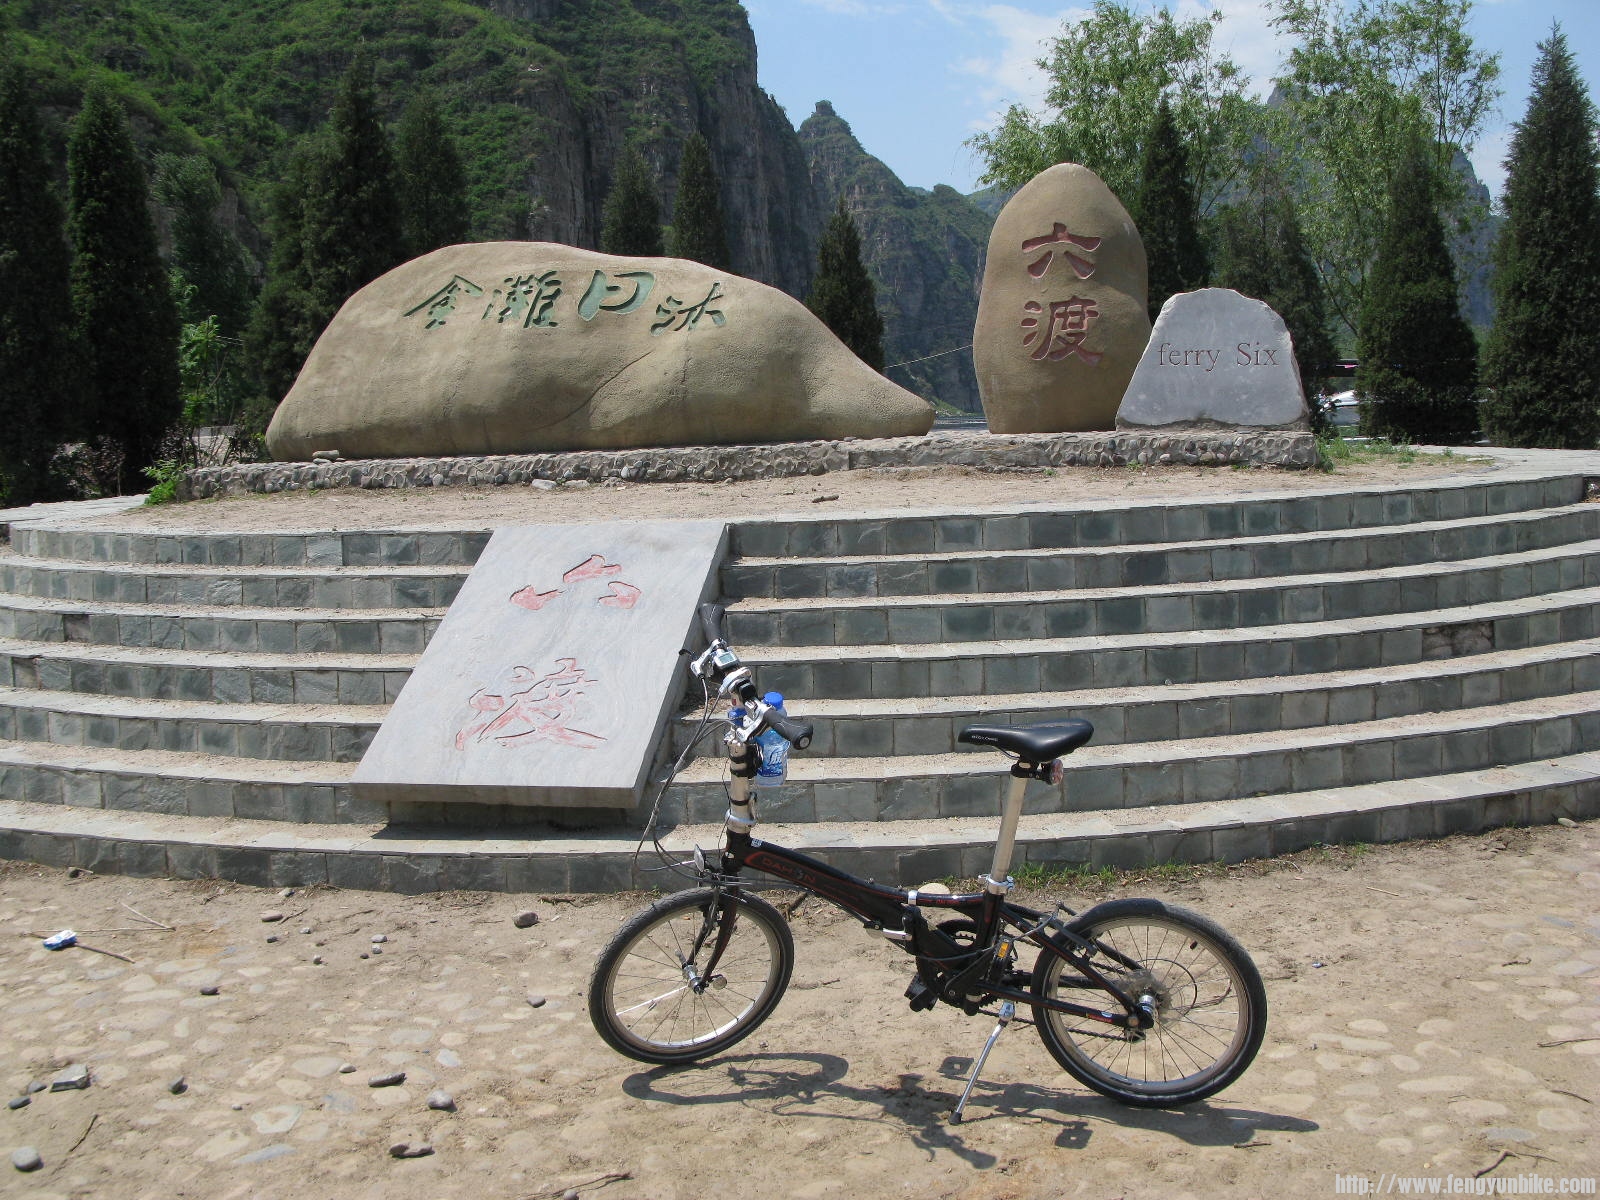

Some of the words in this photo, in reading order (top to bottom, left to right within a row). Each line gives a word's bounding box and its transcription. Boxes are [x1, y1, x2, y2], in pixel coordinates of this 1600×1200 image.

[1021, 222, 1103, 366] 六渡
[1158, 342, 1220, 372] ferry
[1236, 342, 1279, 367] Six
